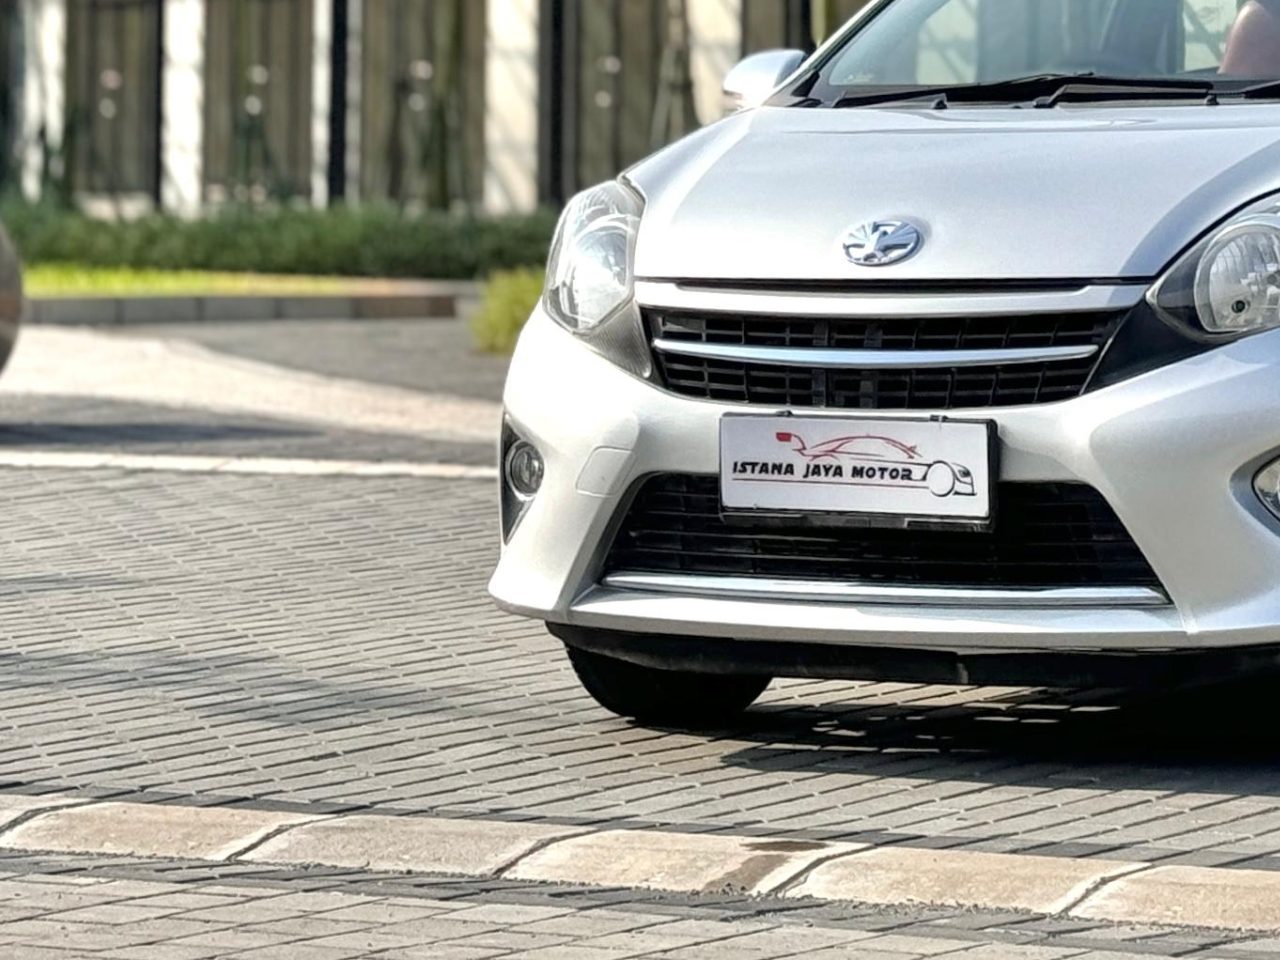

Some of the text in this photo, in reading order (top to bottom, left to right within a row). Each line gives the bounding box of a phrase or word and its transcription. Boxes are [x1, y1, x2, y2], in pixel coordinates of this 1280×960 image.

[732, 461, 913, 481] ISTANA JAYA MOTOR
